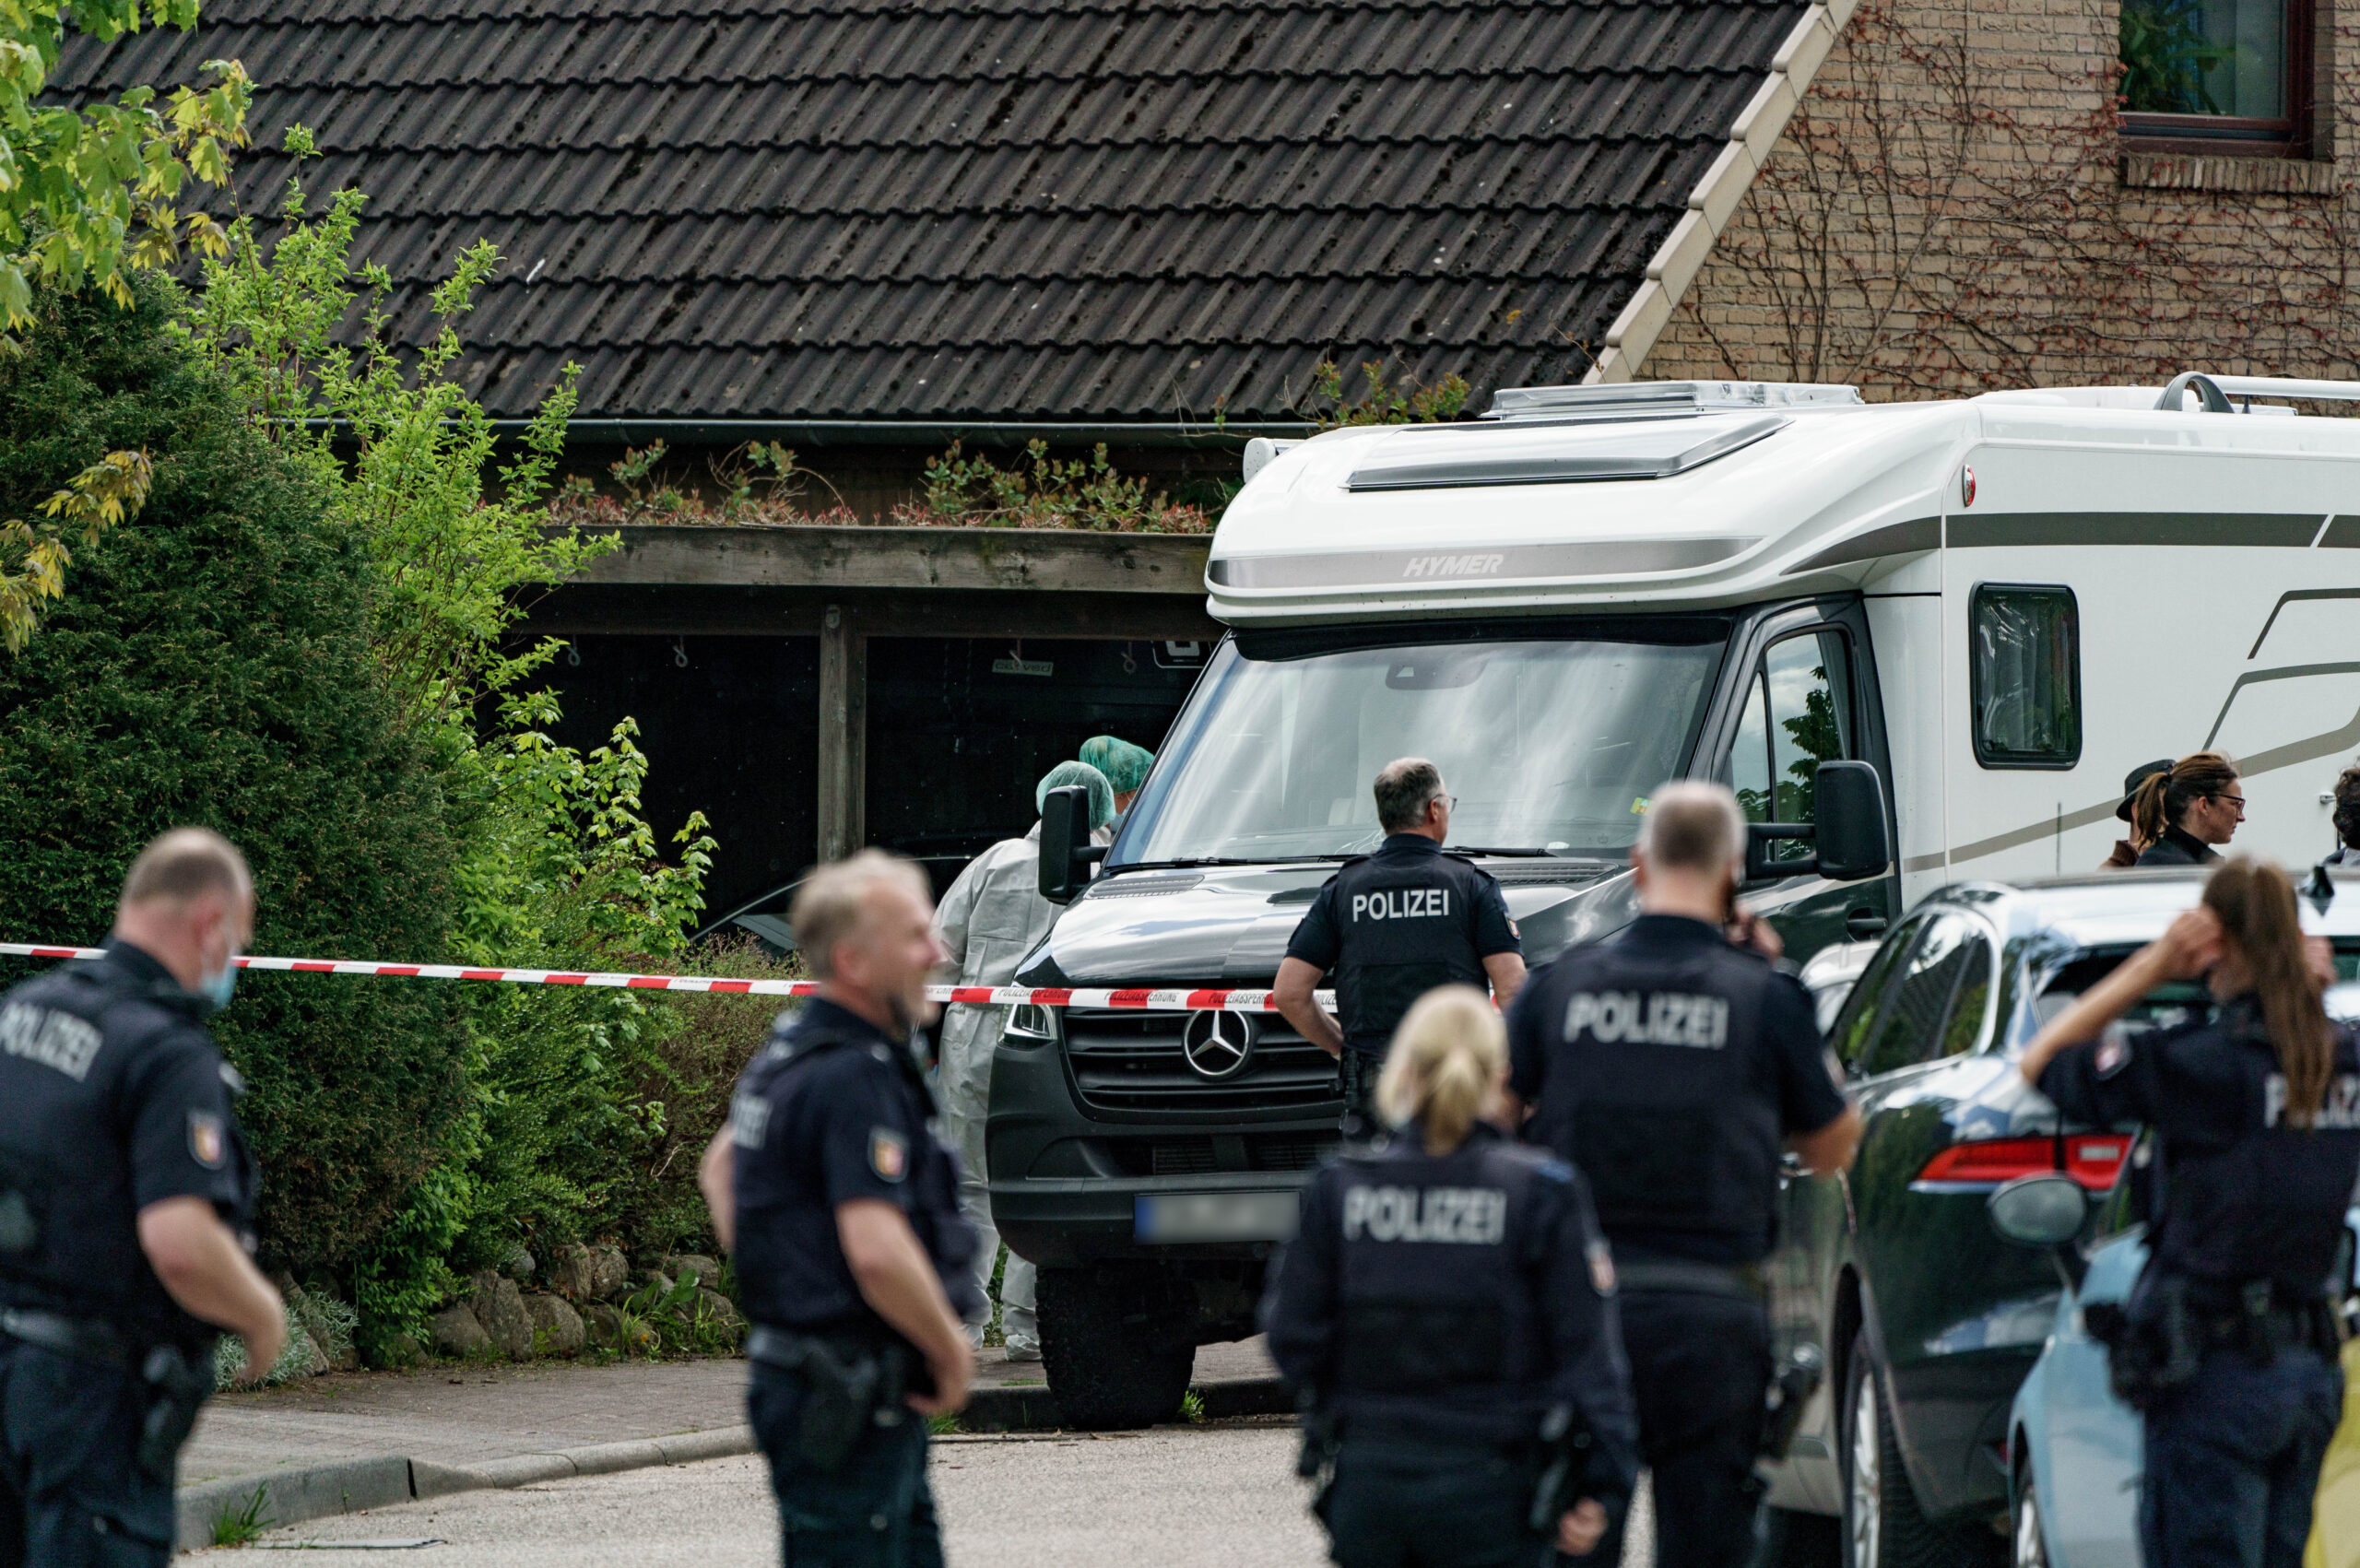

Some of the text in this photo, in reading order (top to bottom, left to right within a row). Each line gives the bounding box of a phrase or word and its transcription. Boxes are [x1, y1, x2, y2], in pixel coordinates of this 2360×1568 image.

[1402, 554, 1504, 577] HYMER
[1352, 890, 1449, 922] POLIZEI
[1564, 989, 1729, 1050] POLIZEI
[1343, 1185, 1507, 1245] POLIZEI
